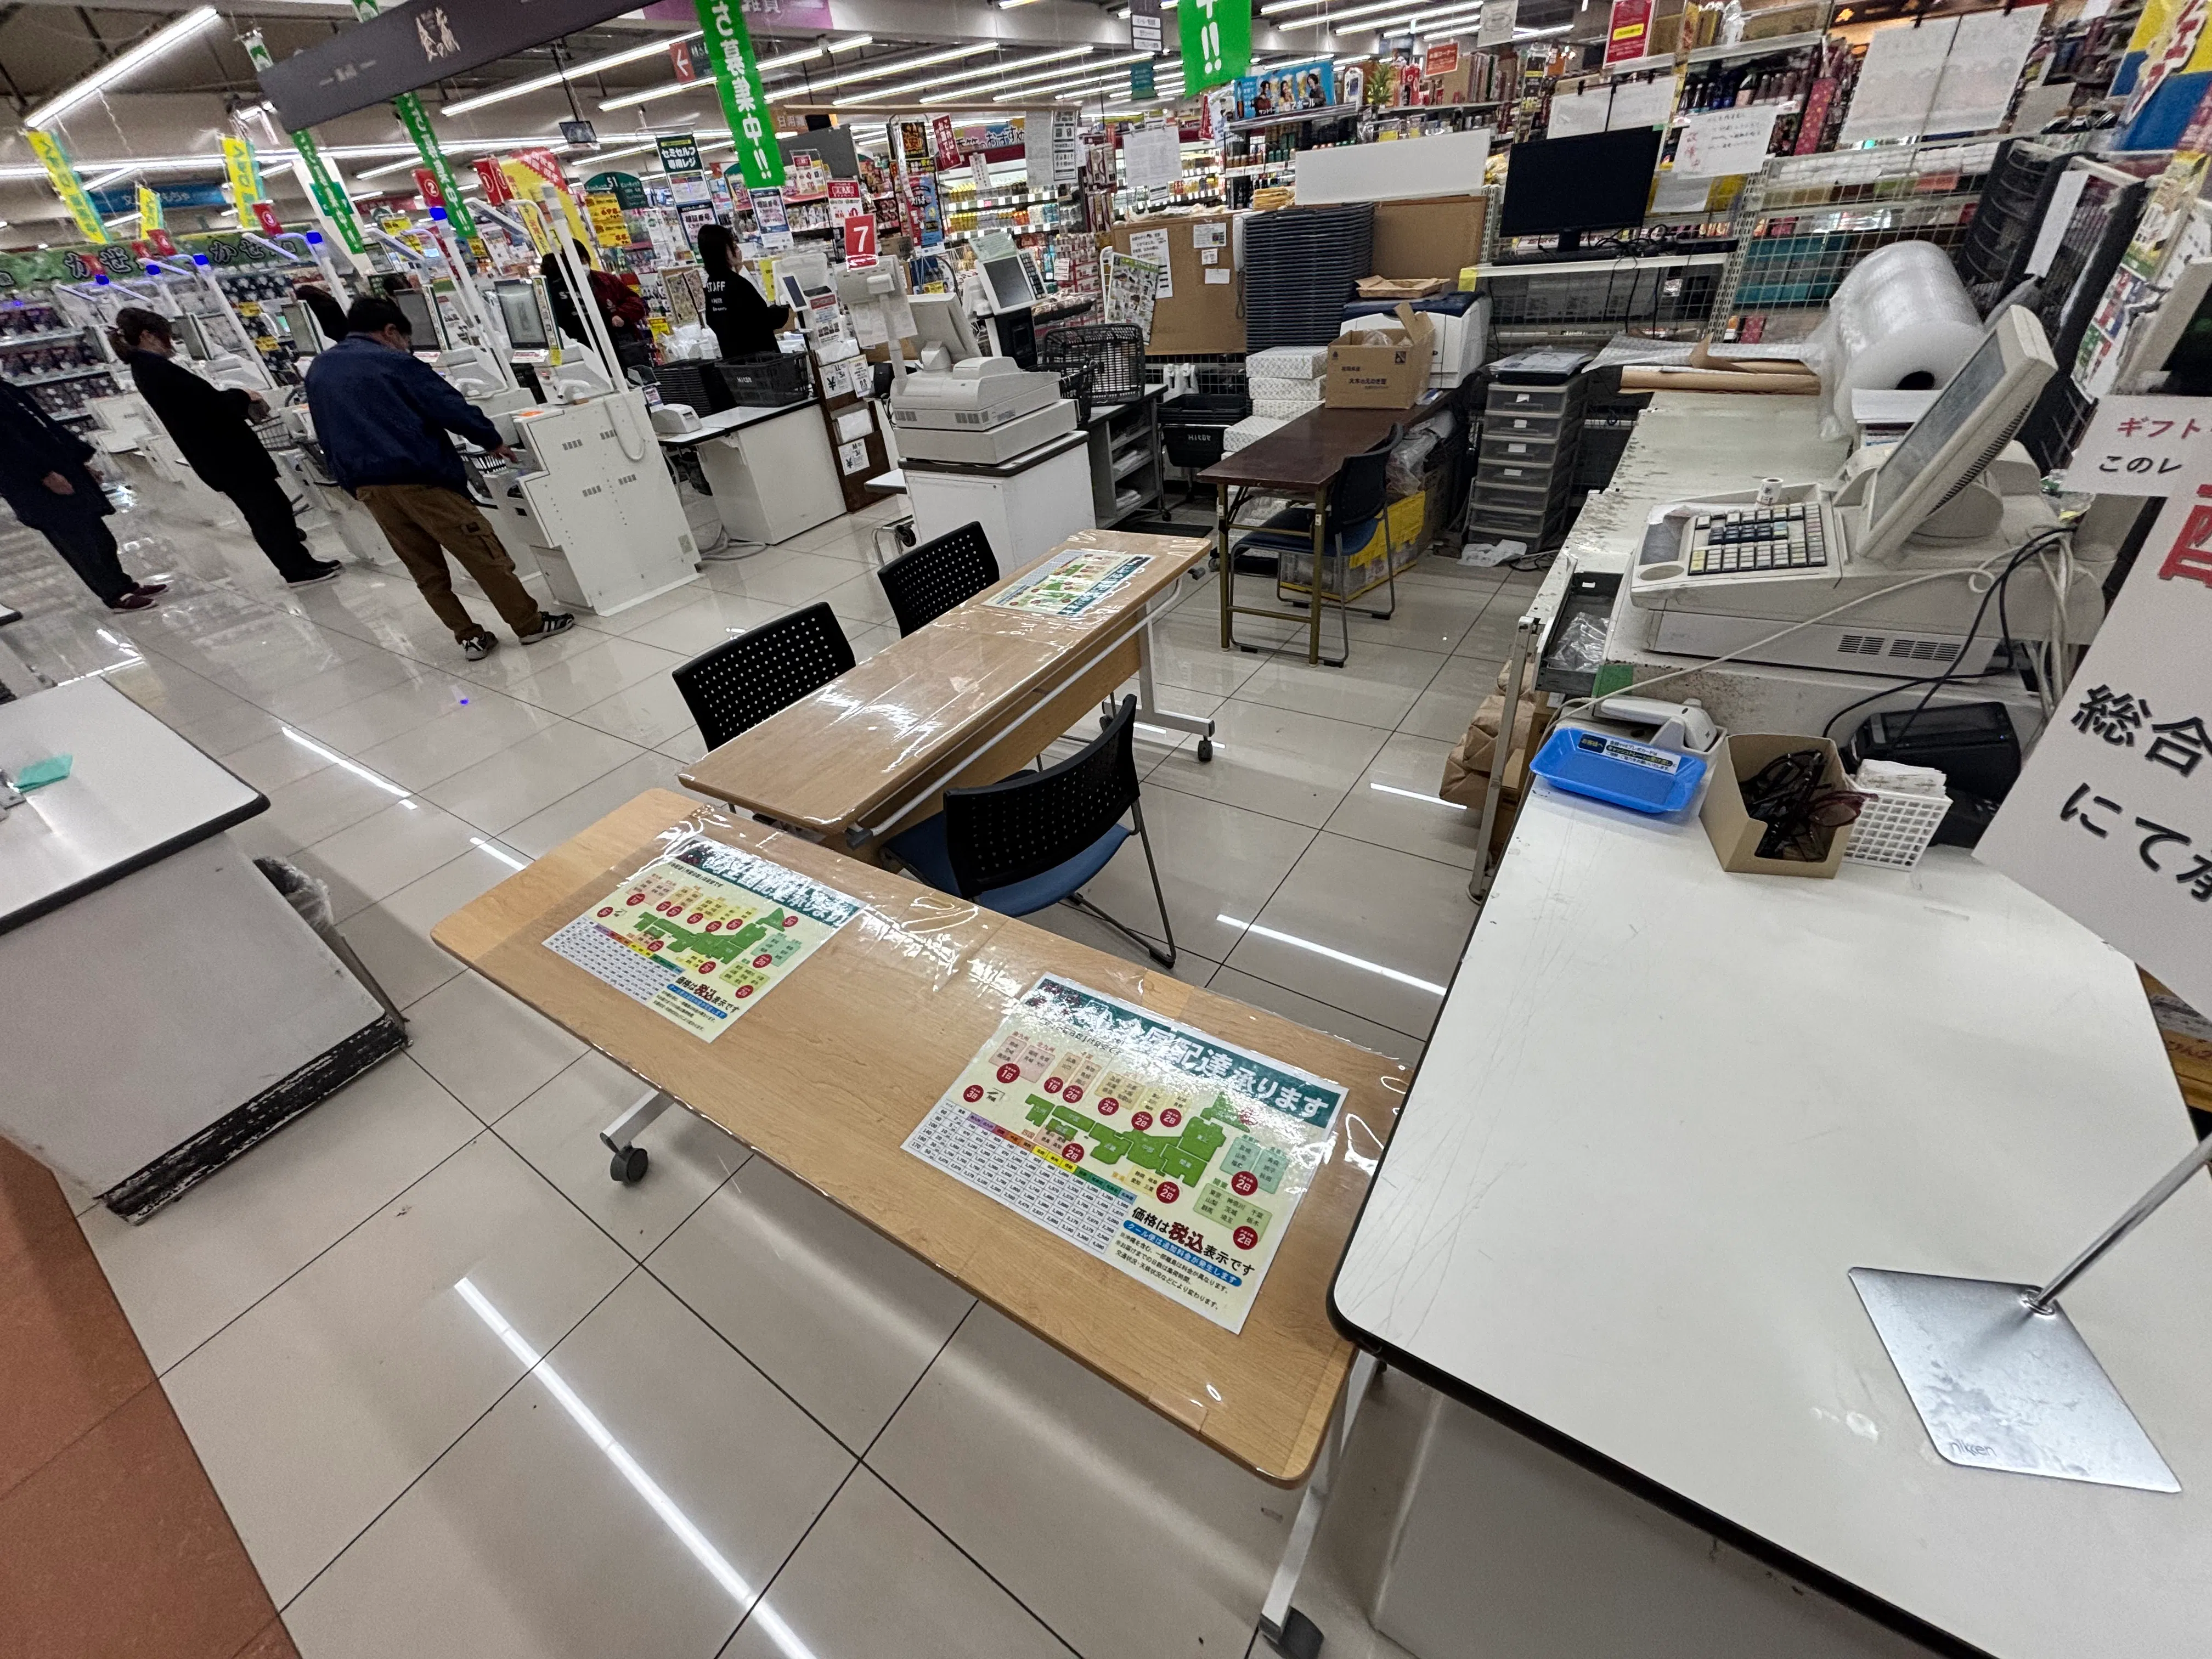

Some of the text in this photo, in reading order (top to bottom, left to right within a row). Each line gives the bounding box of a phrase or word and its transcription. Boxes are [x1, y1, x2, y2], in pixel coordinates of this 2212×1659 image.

[661, 146, 696, 159] セミセルフ
[853, 225, 869, 252] 7
[707, 280, 726, 293] STAFF
[2099, 456, 2183, 475] このレ
[2070, 684, 2212, 778] 総合
[1580, 737, 1605, 749] お客様へ
[673, 973, 744, 1015] 価格は税込表示です
[998, 1068, 1015, 1081] 1日
[1046, 1081, 1059, 1091] 1日
[965, 1090, 980, 1101] 3日
[1065, 1090, 1079, 1101] 2日
[1100, 1102, 1114, 1113] 2日
[927, 1121, 938, 1129] 100
[1133, 1116, 1148, 1128] 2日
[1162, 1113, 1177, 1125] 2日
[922, 1127, 933, 1136] 140
[910, 1141, 922, 1149] 170
[1064, 1148, 1080, 1161] 2日
[1235, 1178, 1252, 1193] 2日
[1159, 1187, 1175, 1201] 2日
[1129, 1201, 1259, 1280] 価格は税込表示です
[1237, 1232, 1253, 1247] 2日
[1126, 1222, 1238, 1285] クール便は追加料金が発生します
